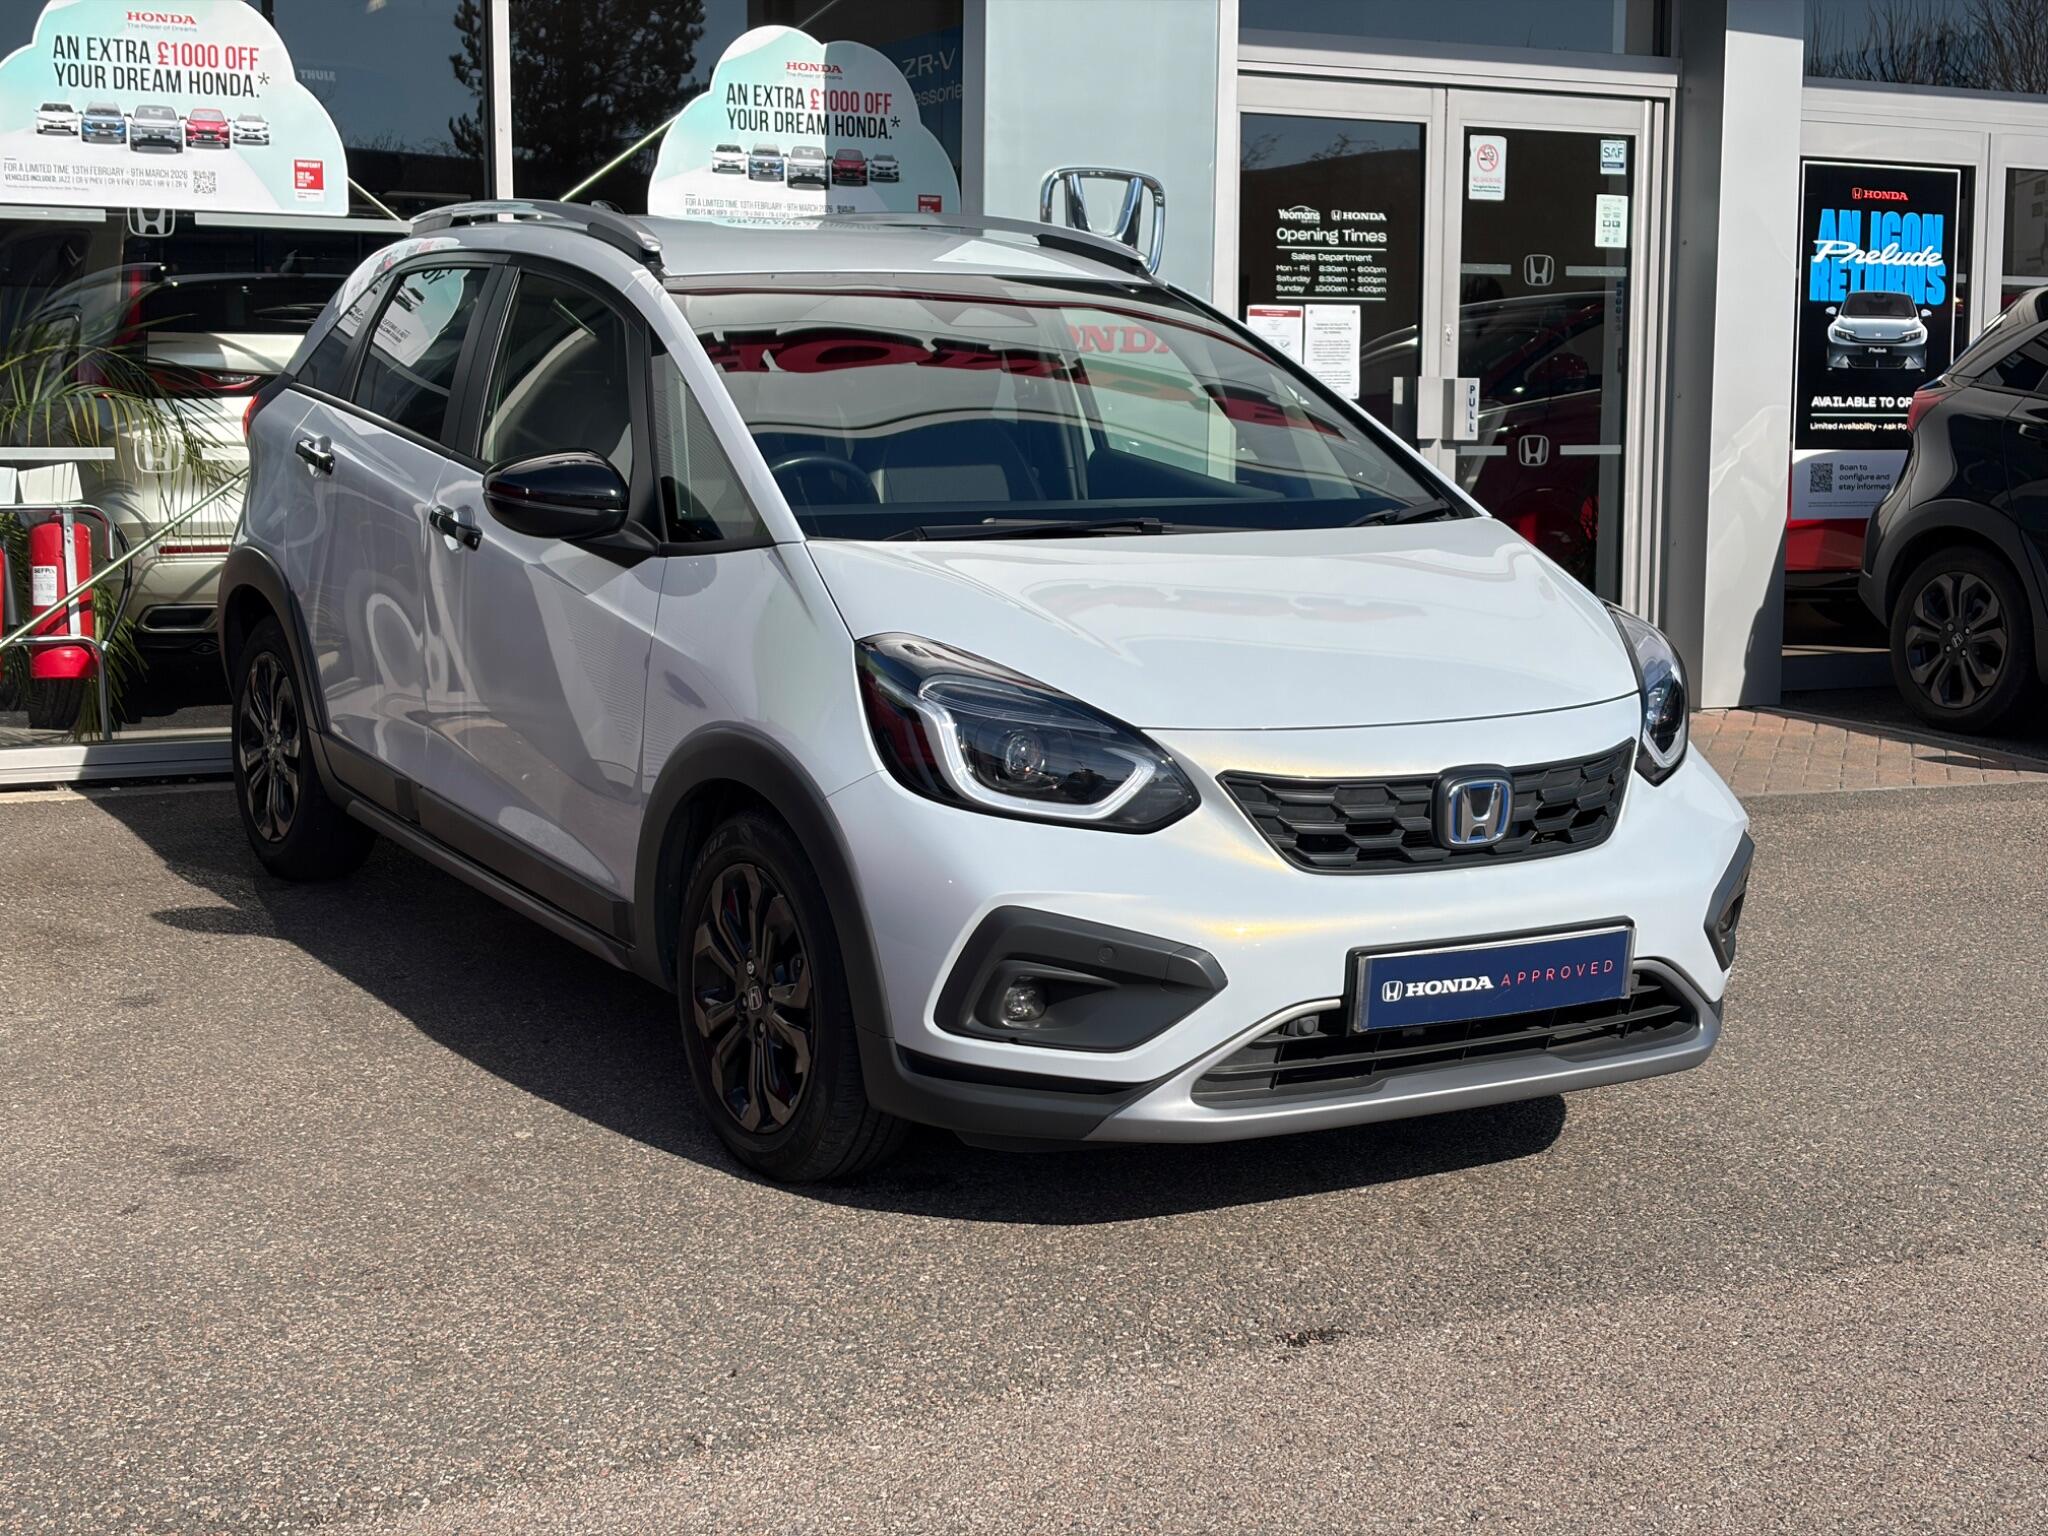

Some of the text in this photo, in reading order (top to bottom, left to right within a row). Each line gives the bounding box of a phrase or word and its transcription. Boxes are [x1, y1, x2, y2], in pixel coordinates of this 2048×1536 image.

[127, 11, 196, 25] HONDA
[53, 35, 260, 71] AN EXTRA £1000 OFF
[786, 61, 843, 74] HONDA
[902, 47, 956, 79] ZR-V
[54, 63, 107, 89] YOUR
[113, 66, 181, 94] DREAM
[726, 83, 892, 115] AN EXTRA £1000 OFF
[727, 108, 769, 132] YOUR
[774, 111, 829, 136] DREAM
[1603, 146, 1624, 159] SAF
[4, 162, 18, 172] FOR
[19, 163, 25, 172] A
[25, 163, 52, 174] LIMITED
[53, 164, 70, 175] TIME
[72, 165, 89, 175] 13TH
[90, 166, 125, 177] FEBRUARY
[145, 168, 170, 179] MARCH
[170, 169, 189, 180] 2026
[1864, 190, 1909, 201] HONDA
[1278, 208, 1387, 221] Yeomans HONDA
[1276, 227, 1388, 245] Opening Times
[1816, 208, 1944, 254] AN ICON
[1290, 252, 1373, 262] Sales Department
[1812, 240, 1944, 267] Prelude
[1276, 264, 1292, 272] Mon
[1299, 264, 1310, 272] Fri
[1318, 265, 1348, 273] 8:30am
[1276, 275, 1311, 284] Saturday
[1318, 275, 1348, 283] 8:30am
[1809, 254, 1947, 305] RETURNS
[1276, 284, 1305, 293] Sunday
[1468, 384, 1476, 433] PULL
[1810, 396, 1877, 408] AVAILABLE
[1878, 396, 1895, 408] TO
[1810, 422, 1838, 430] Limited
[1838, 422, 1877, 432] Availability
[1839, 463, 1868, 471] Scan to
[1838, 473, 1890, 482] configure and
[1838, 484, 1855, 492] stay
[1404, 959, 1614, 998] HONDA APPROVED
